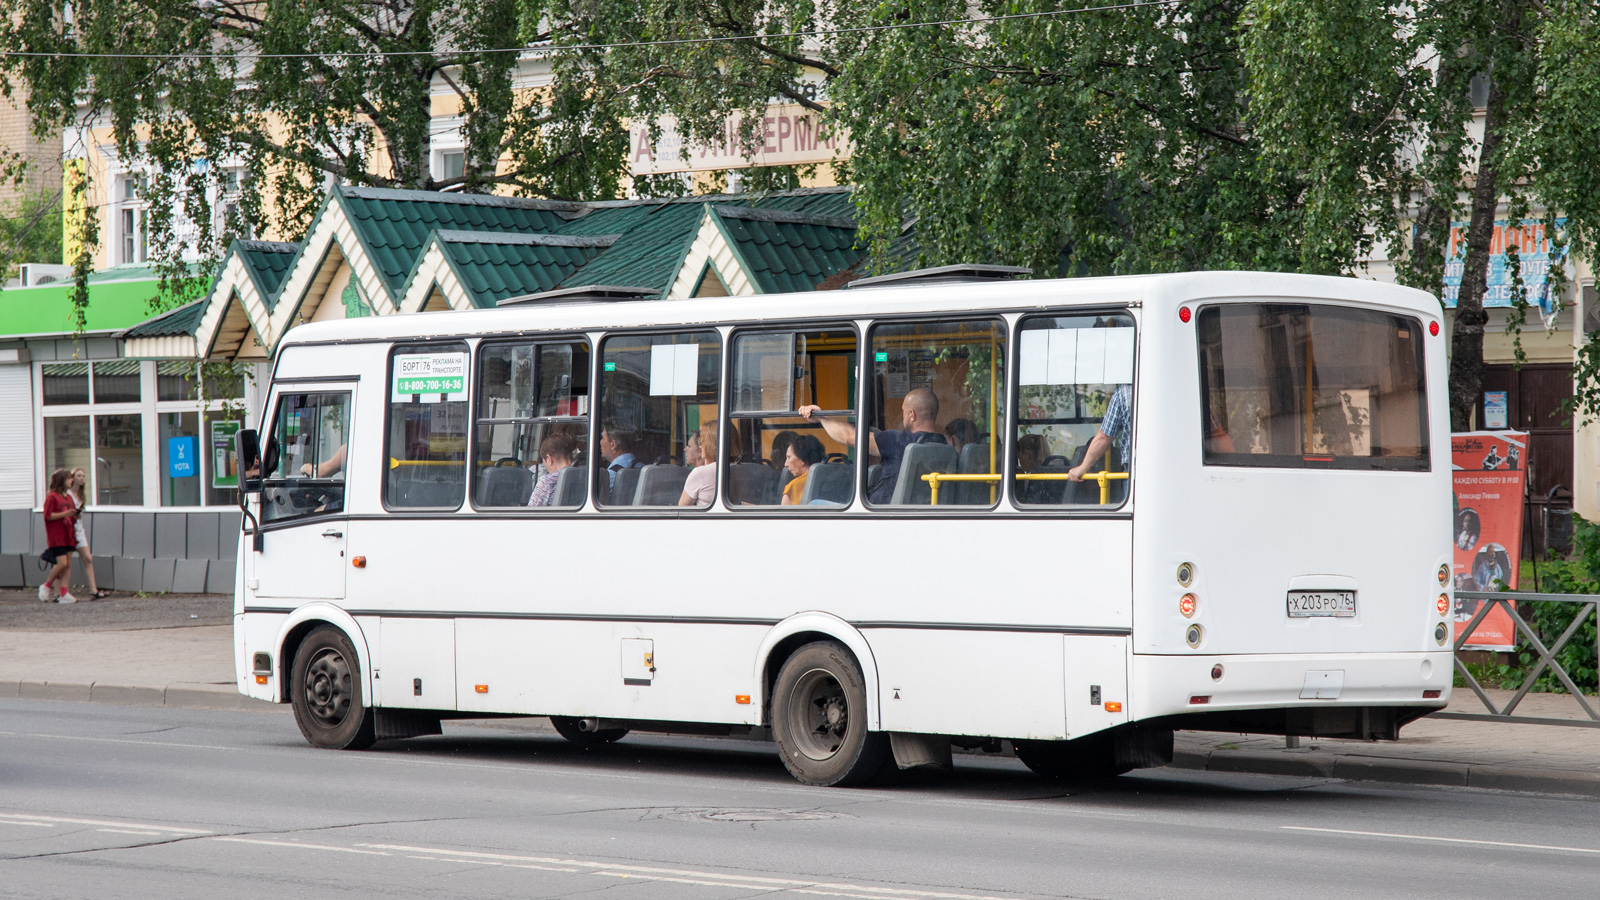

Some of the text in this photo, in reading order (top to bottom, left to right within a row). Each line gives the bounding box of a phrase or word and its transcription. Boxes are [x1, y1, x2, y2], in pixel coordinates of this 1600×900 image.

[1451, 224, 1548, 256] РМОНТ
[402, 361, 431, 371] БОРТ 76
[432, 366, 462, 374] ТРАНСПОРТЕ
[404, 379, 462, 391] 8-800-700-16-36
[174, 462, 190, 471] YOTA
